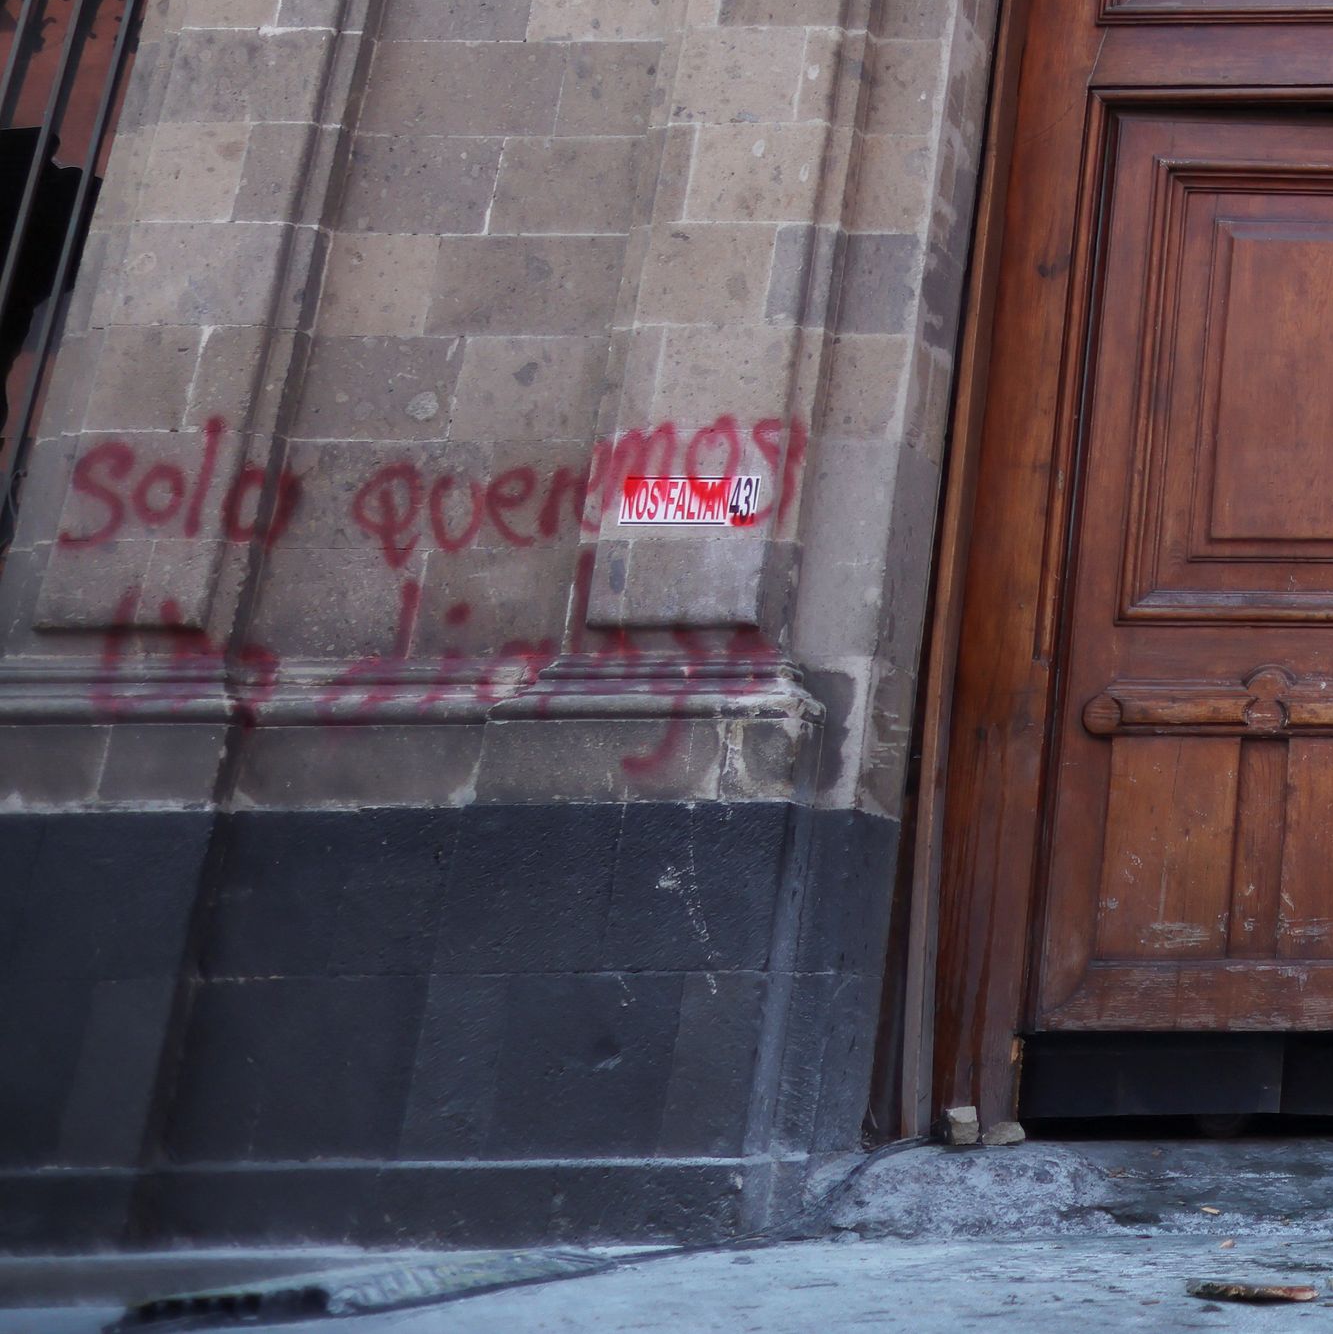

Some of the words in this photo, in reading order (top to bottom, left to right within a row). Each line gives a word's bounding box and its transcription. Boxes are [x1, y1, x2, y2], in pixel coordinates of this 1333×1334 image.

[621, 479, 661, 520] NOS
[663, 479, 732, 520] FALTAN
[729, 476, 760, 523] 43!
